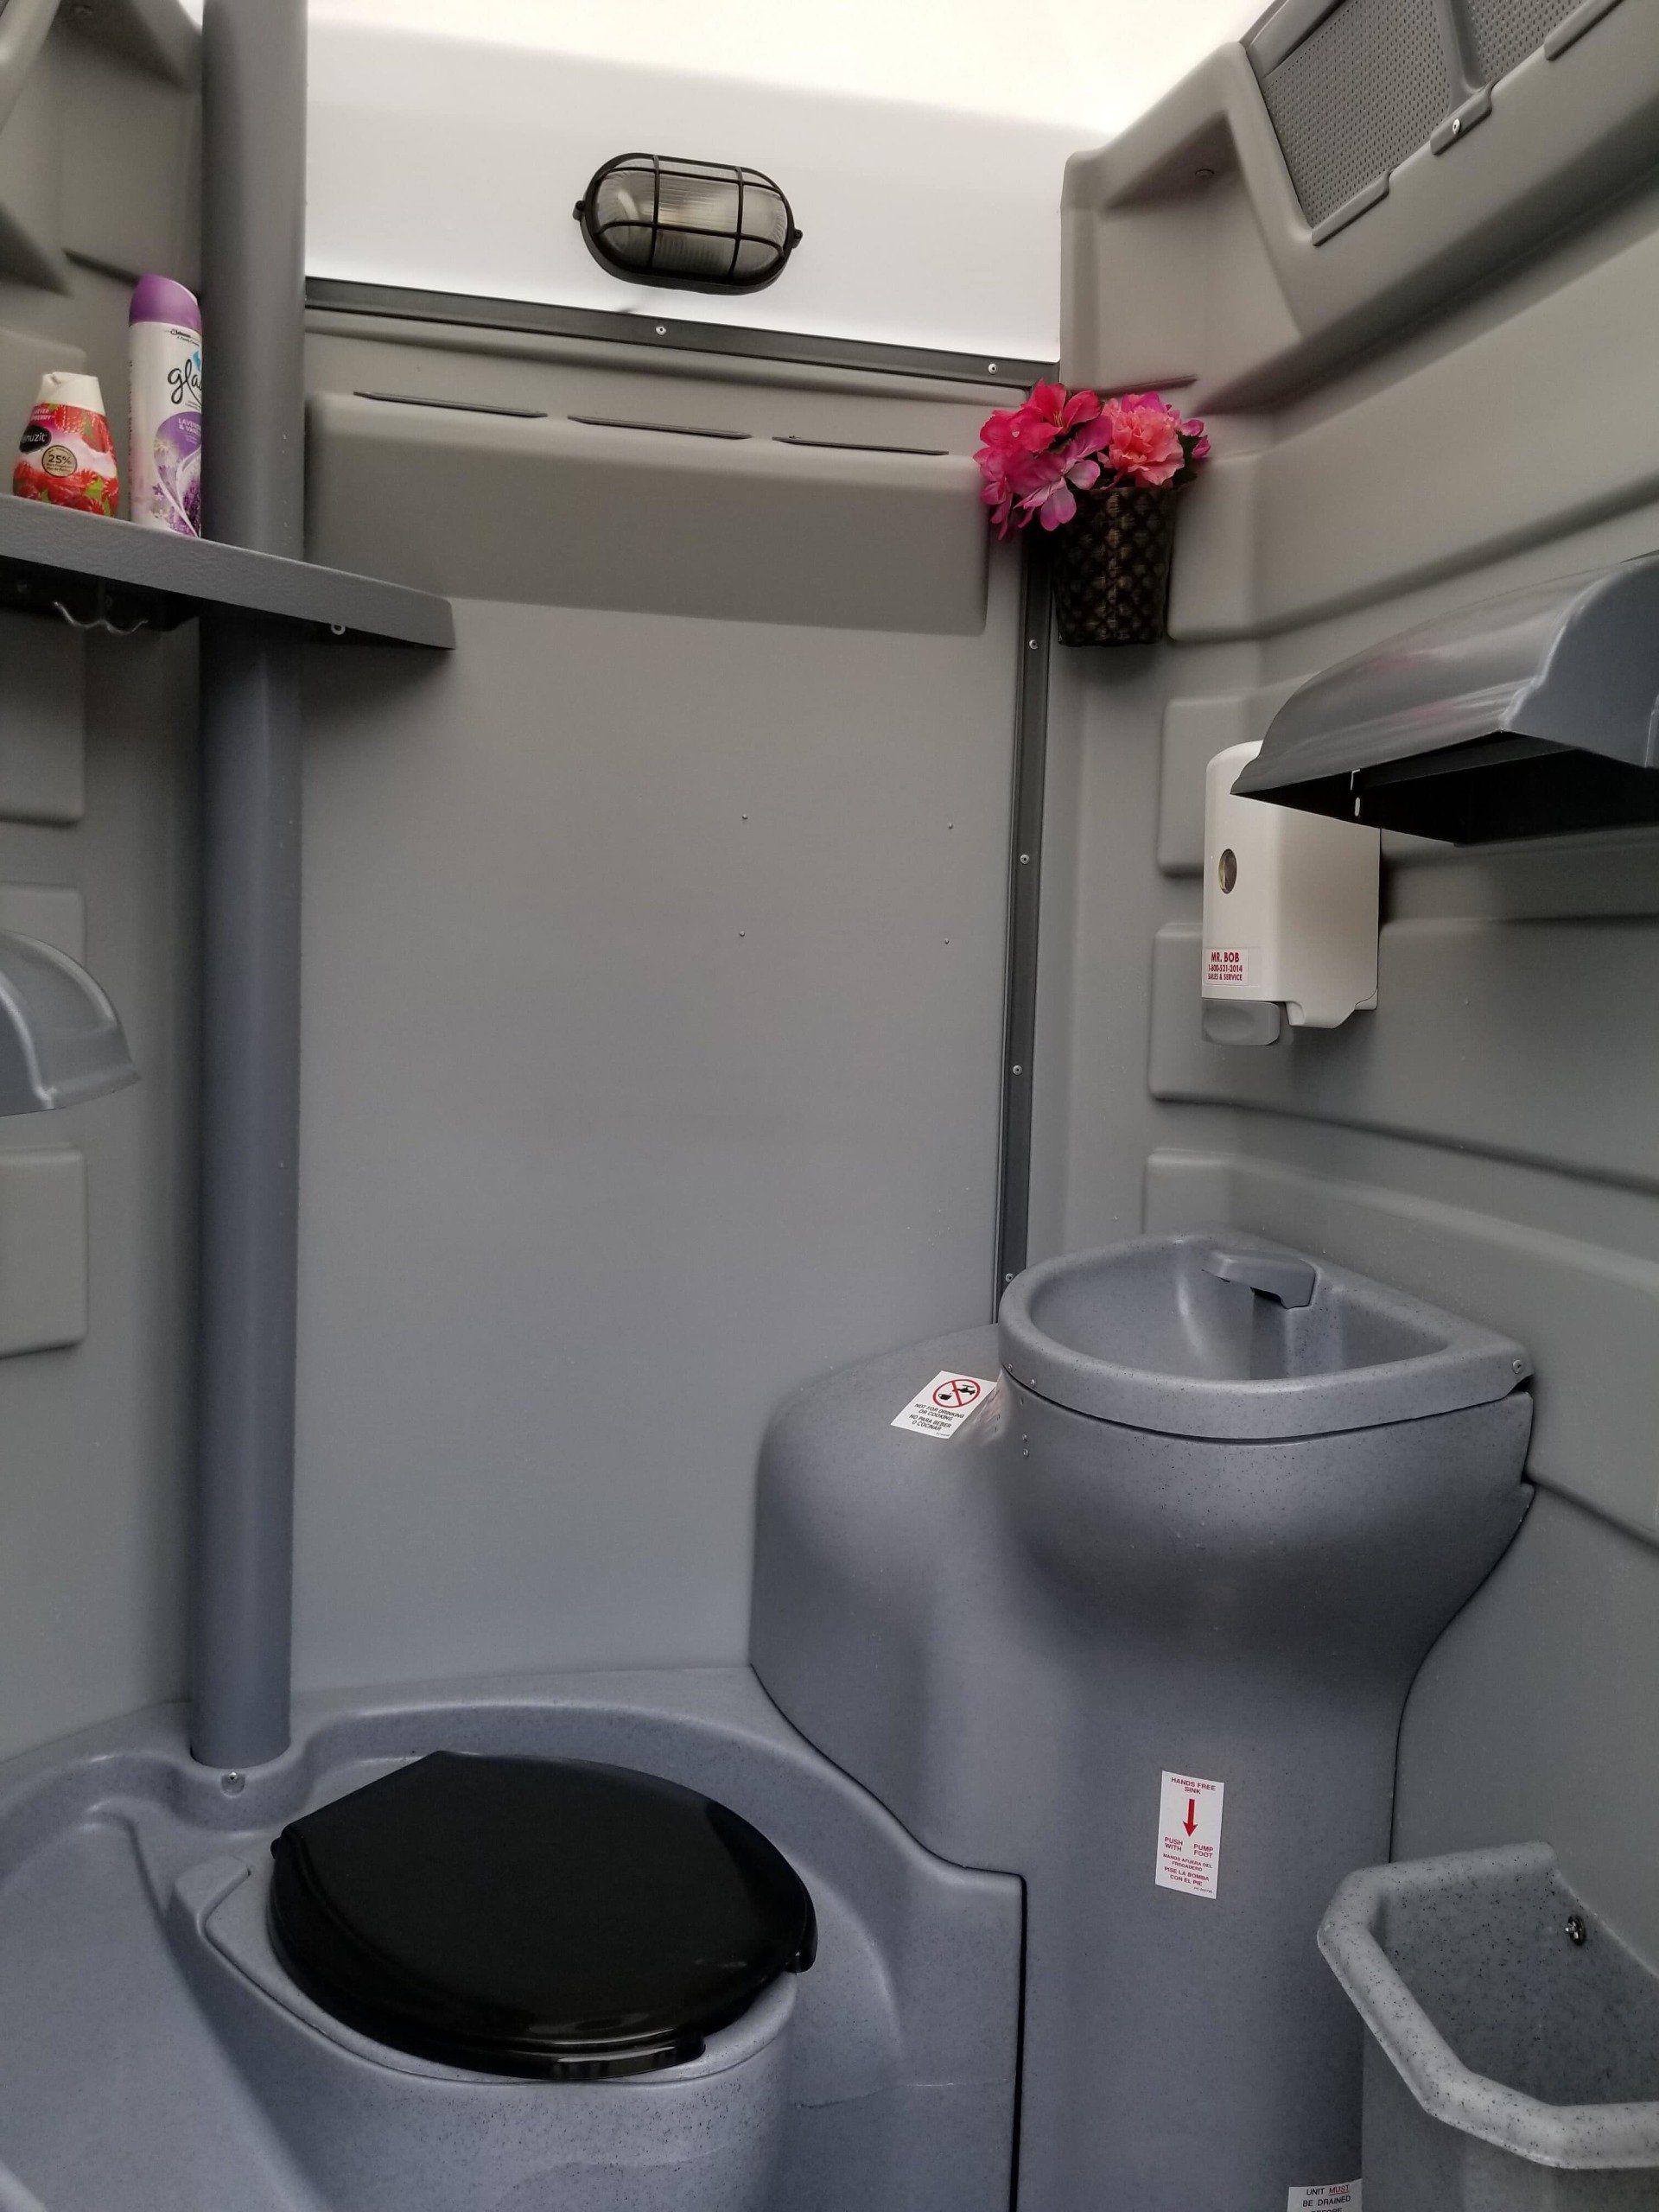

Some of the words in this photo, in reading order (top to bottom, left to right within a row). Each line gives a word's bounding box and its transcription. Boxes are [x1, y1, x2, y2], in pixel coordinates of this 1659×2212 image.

[48, 454, 72, 465] 25%
[1211, 952, 1222, 963] MR.
[1224, 952, 1239, 963] BOB
[927, 1412, 953, 1421] COOKING
[938, 1409, 965, 1419] DRINKING
[917, 1421, 942, 1431] COCINAR
[1171, 1777, 1195, 1788] HANDS
[1197, 1782, 1216, 1791] FREE
[1184, 1786, 1201, 1795] SINK
[1164, 1836, 1183, 1846] PUSH
[1165, 1843, 1182, 1852] WITH
[1193, 1843, 1214, 1853] PUMP
[1193, 1849, 1213, 1859] FOOT
[1162, 1853, 1180, 1863] MANOS
[1181, 1858, 1201, 1866] AFUERA
[1172, 1861, 1203, 1872] FREGADERO
[1169, 1874, 1183, 1883] CON
[1187, 1872, 1210, 1882] BOMBA
[1329, 2184, 1350, 2195] MUST
[1318, 2195, 1351, 2206] DRAINED
